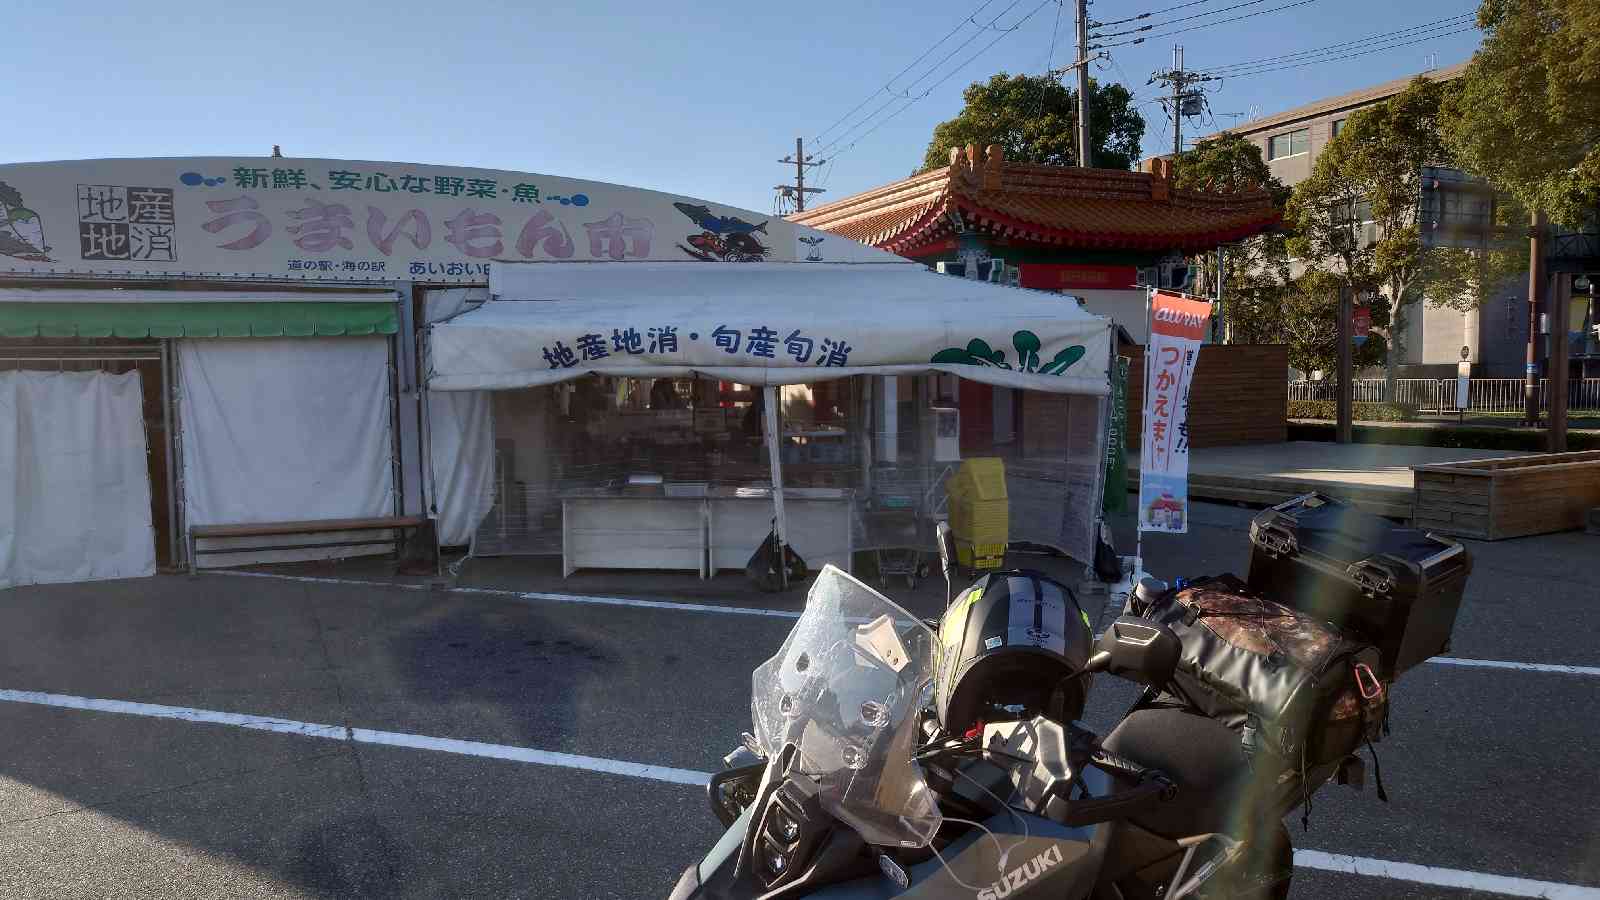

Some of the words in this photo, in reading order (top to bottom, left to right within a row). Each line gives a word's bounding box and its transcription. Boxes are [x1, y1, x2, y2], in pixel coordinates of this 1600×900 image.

[233, 166, 541, 203] 新鮮、安心な野菜・魚
[80, 187, 174, 223] 地産
[81, 224, 174, 260] 地消
[202, 195, 656, 259] うまいもん市
[542, 325, 853, 369] 地産地消・旬産旬消
[976, 844, 1064, 900] SUZUKI
